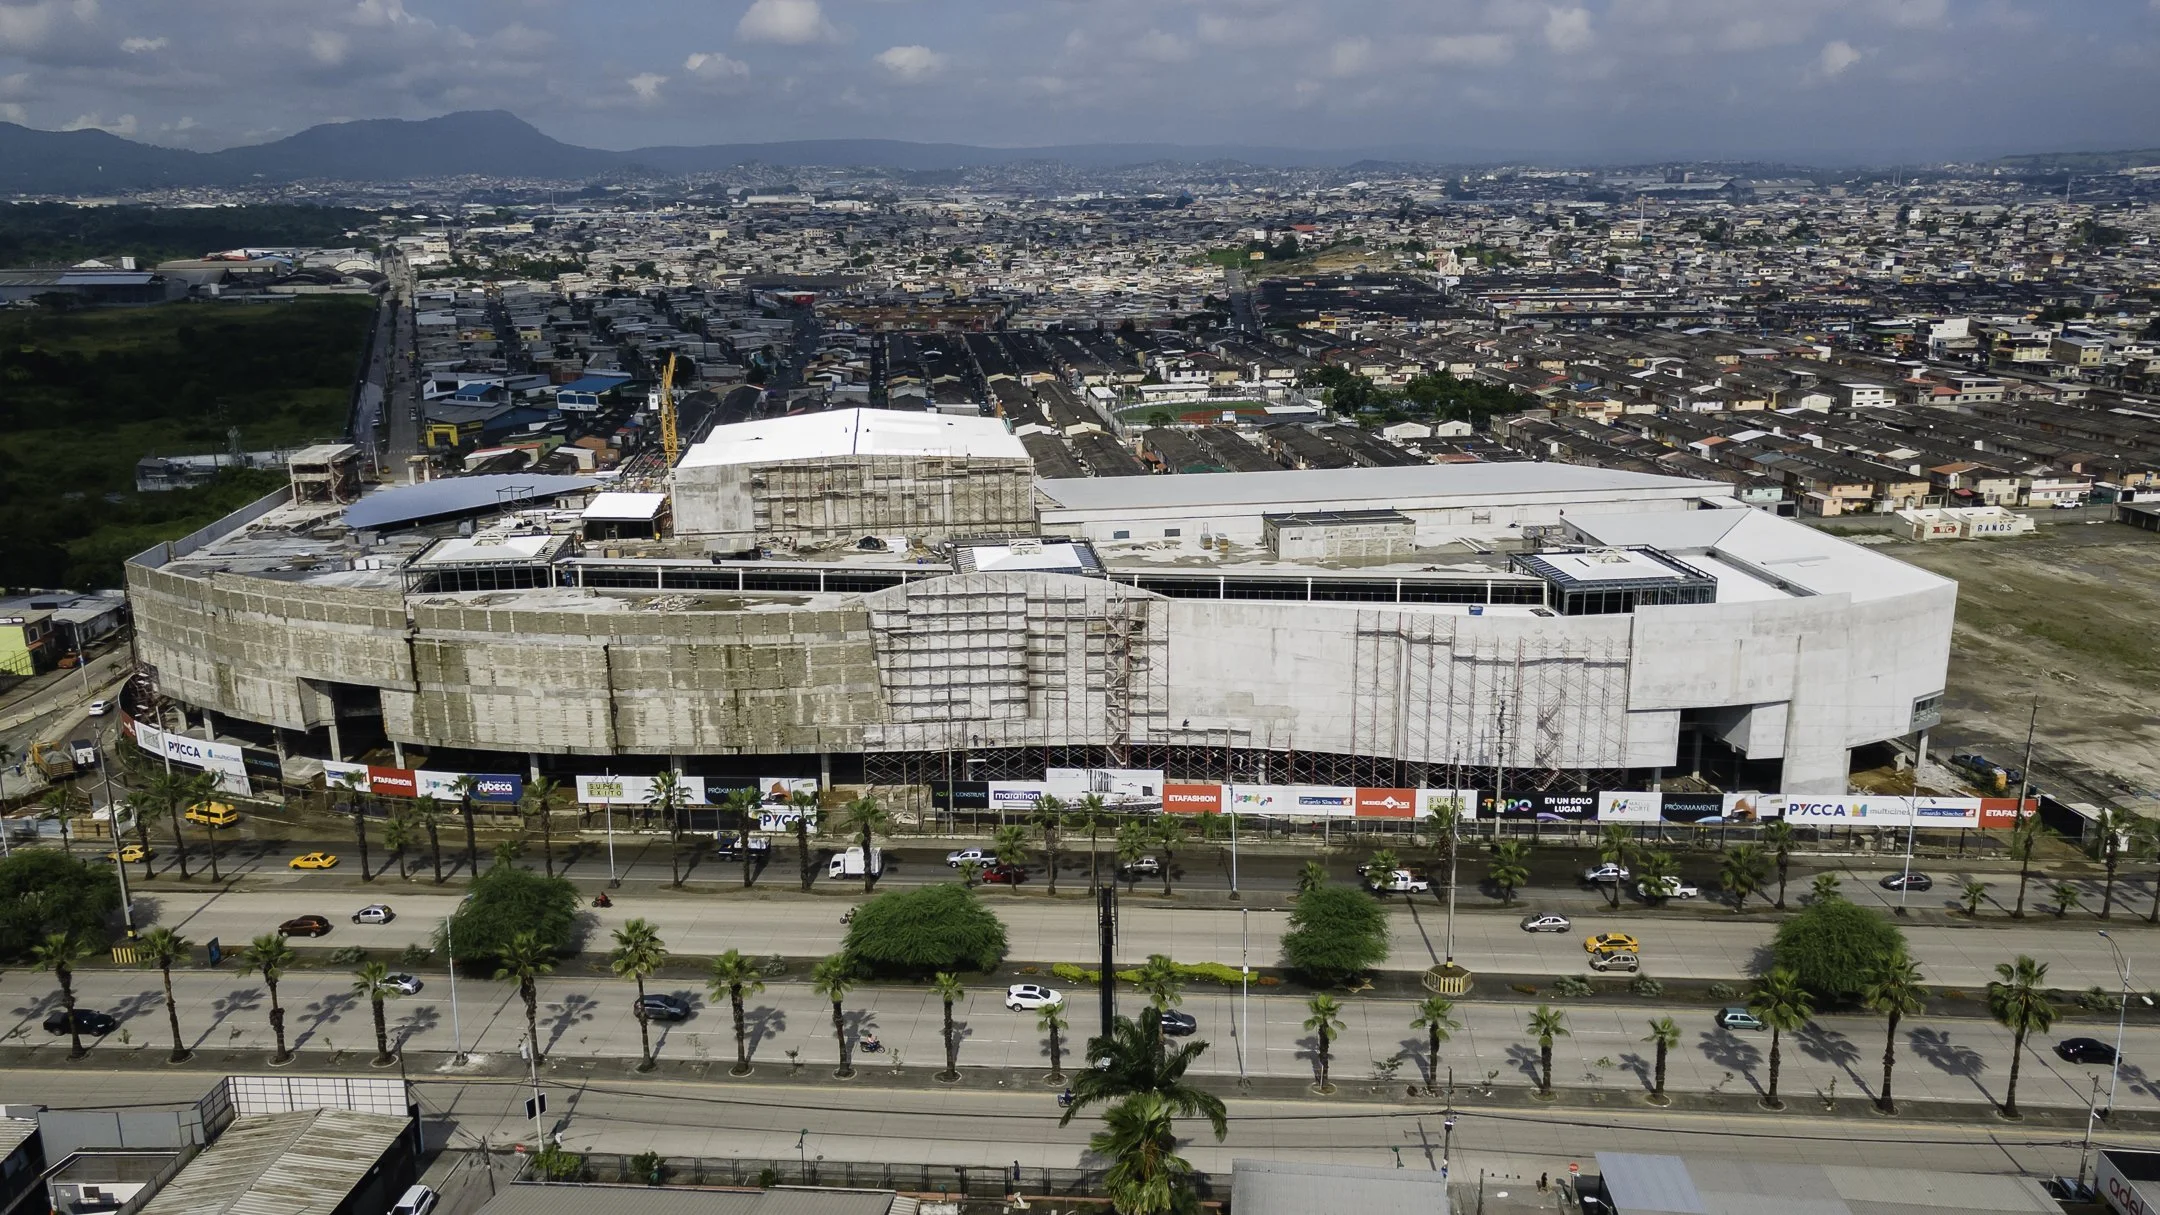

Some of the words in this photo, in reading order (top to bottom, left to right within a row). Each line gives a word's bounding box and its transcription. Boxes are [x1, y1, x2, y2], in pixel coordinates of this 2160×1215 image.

[168, 741, 200, 758] PYCCA
[995, 792, 1040, 800] marathon
[1169, 794, 1216, 802] ETAFASHION
[1545, 797, 1555, 805] EN
[1557, 797, 1569, 805] UN
[1570, 797, 1592, 805] SOLO
[1555, 805, 1582, 813] LUGAR
[1664, 803, 1719, 811] PRÓXIMAMENTE
[1789, 803, 1846, 816] PYCCA
